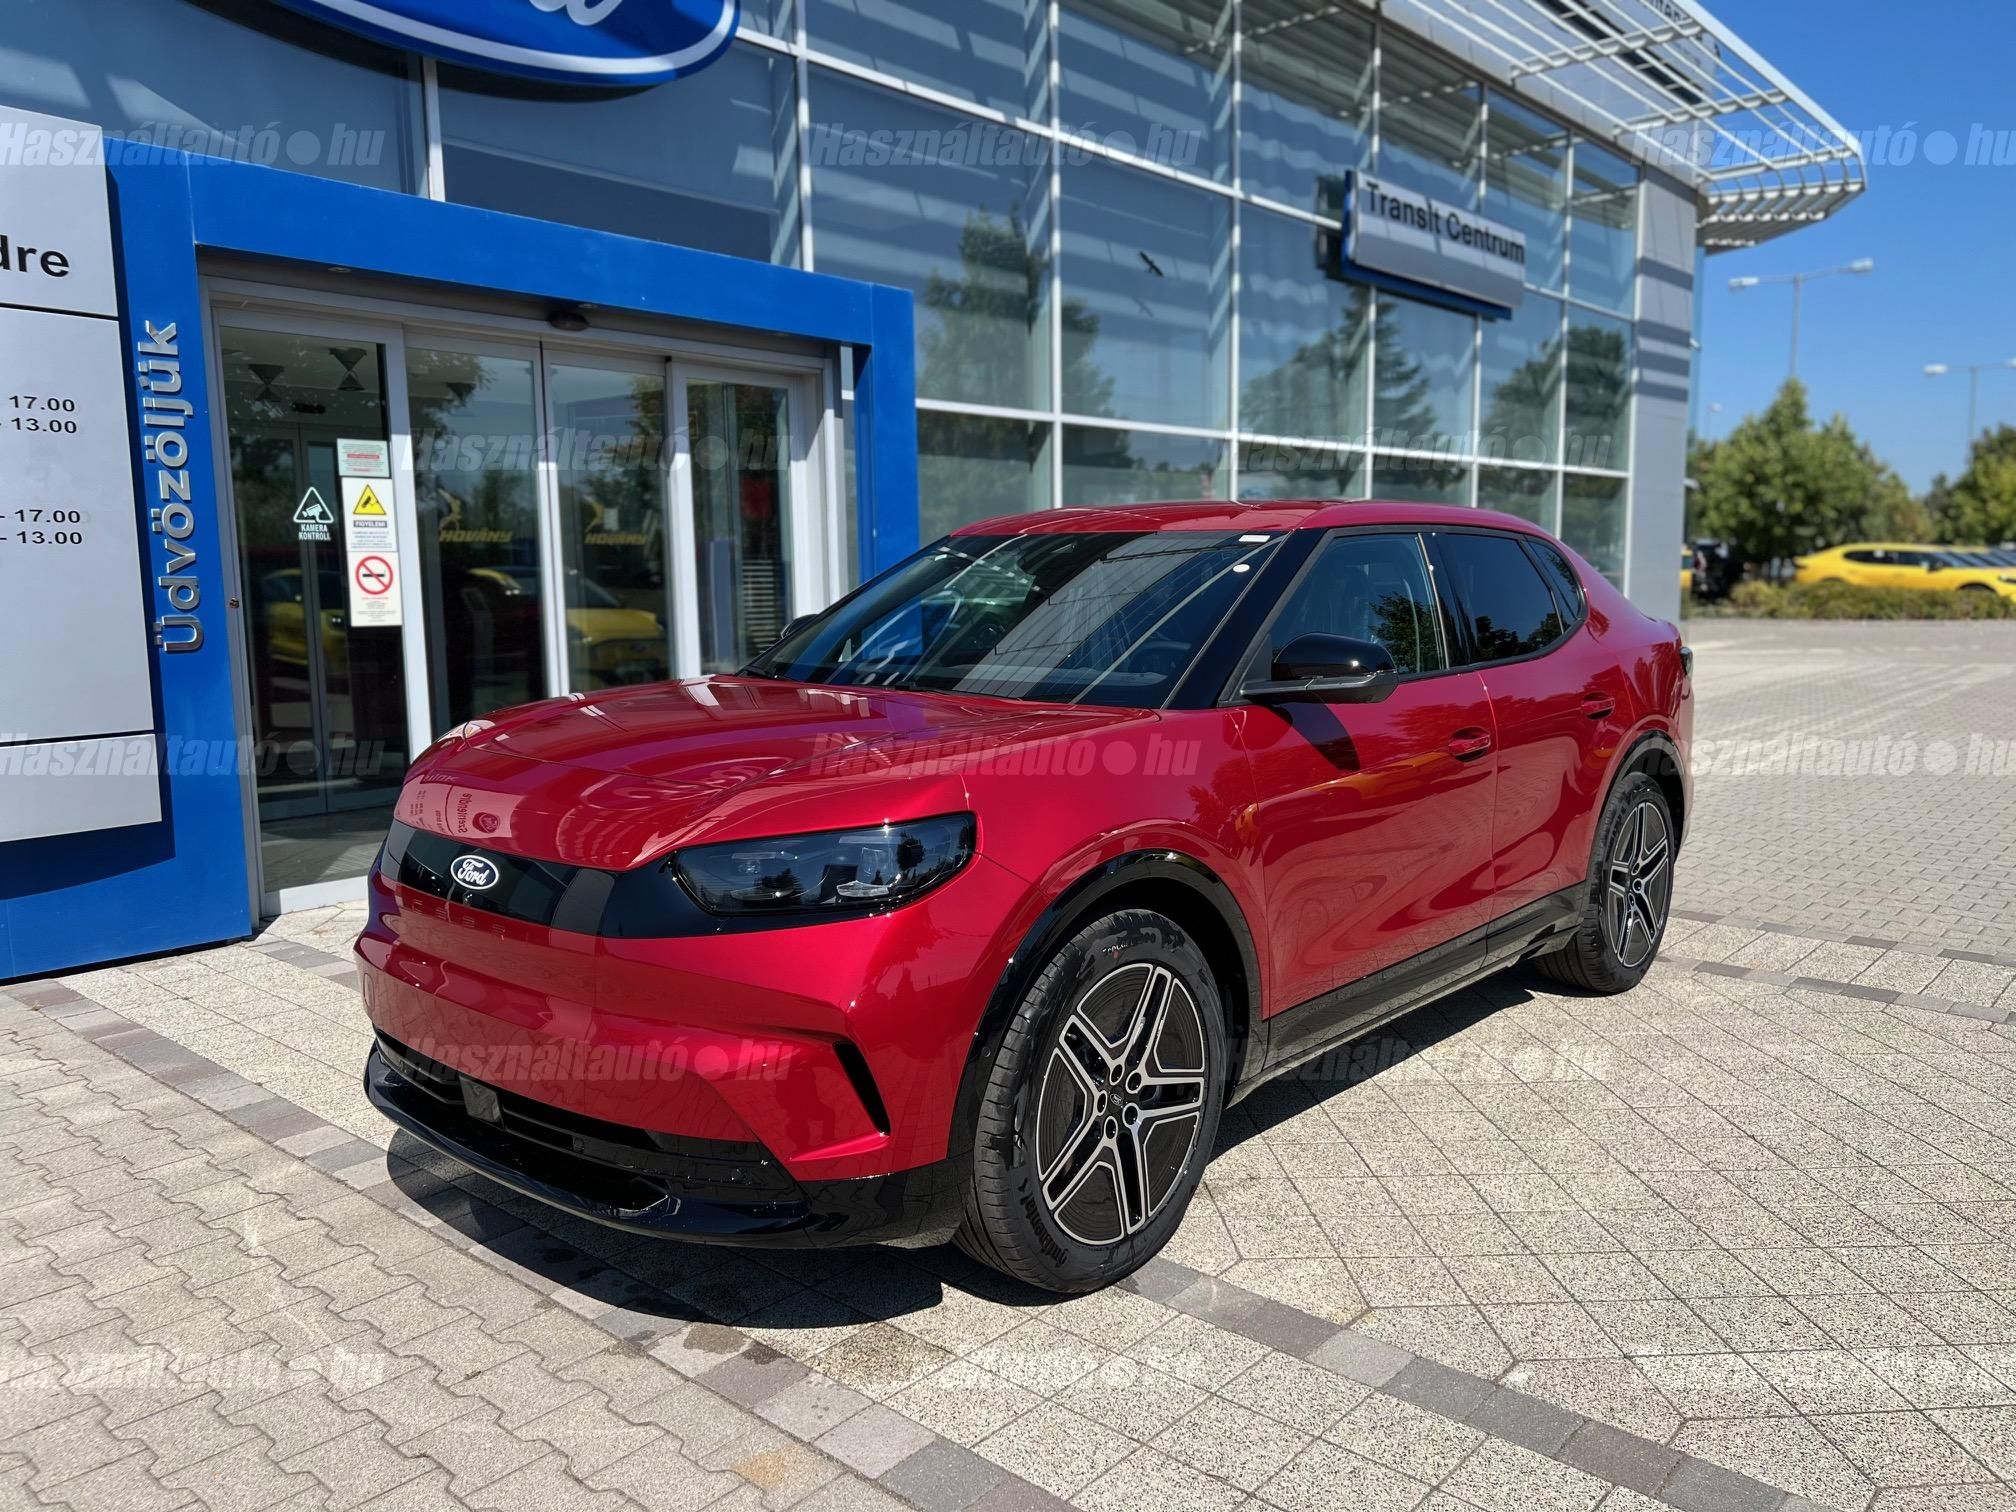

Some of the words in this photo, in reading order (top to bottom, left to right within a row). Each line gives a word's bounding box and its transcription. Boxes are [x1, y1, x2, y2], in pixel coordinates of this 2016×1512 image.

[1366, 182, 1441, 234] Transit
[1447, 212, 1526, 265] Centrum
[9, 395, 75, 412] 17.00
[11, 417, 77, 434] 13.00
[138, 319, 205, 652] Üdvözöljük
[15, 509, 81, 523] 17.00
[299, 532, 331, 541] KONTROLL
[301, 524, 328, 532] KAMERA
[17, 531, 82, 544] 13.00
[456, 857, 491, 886] Ford
